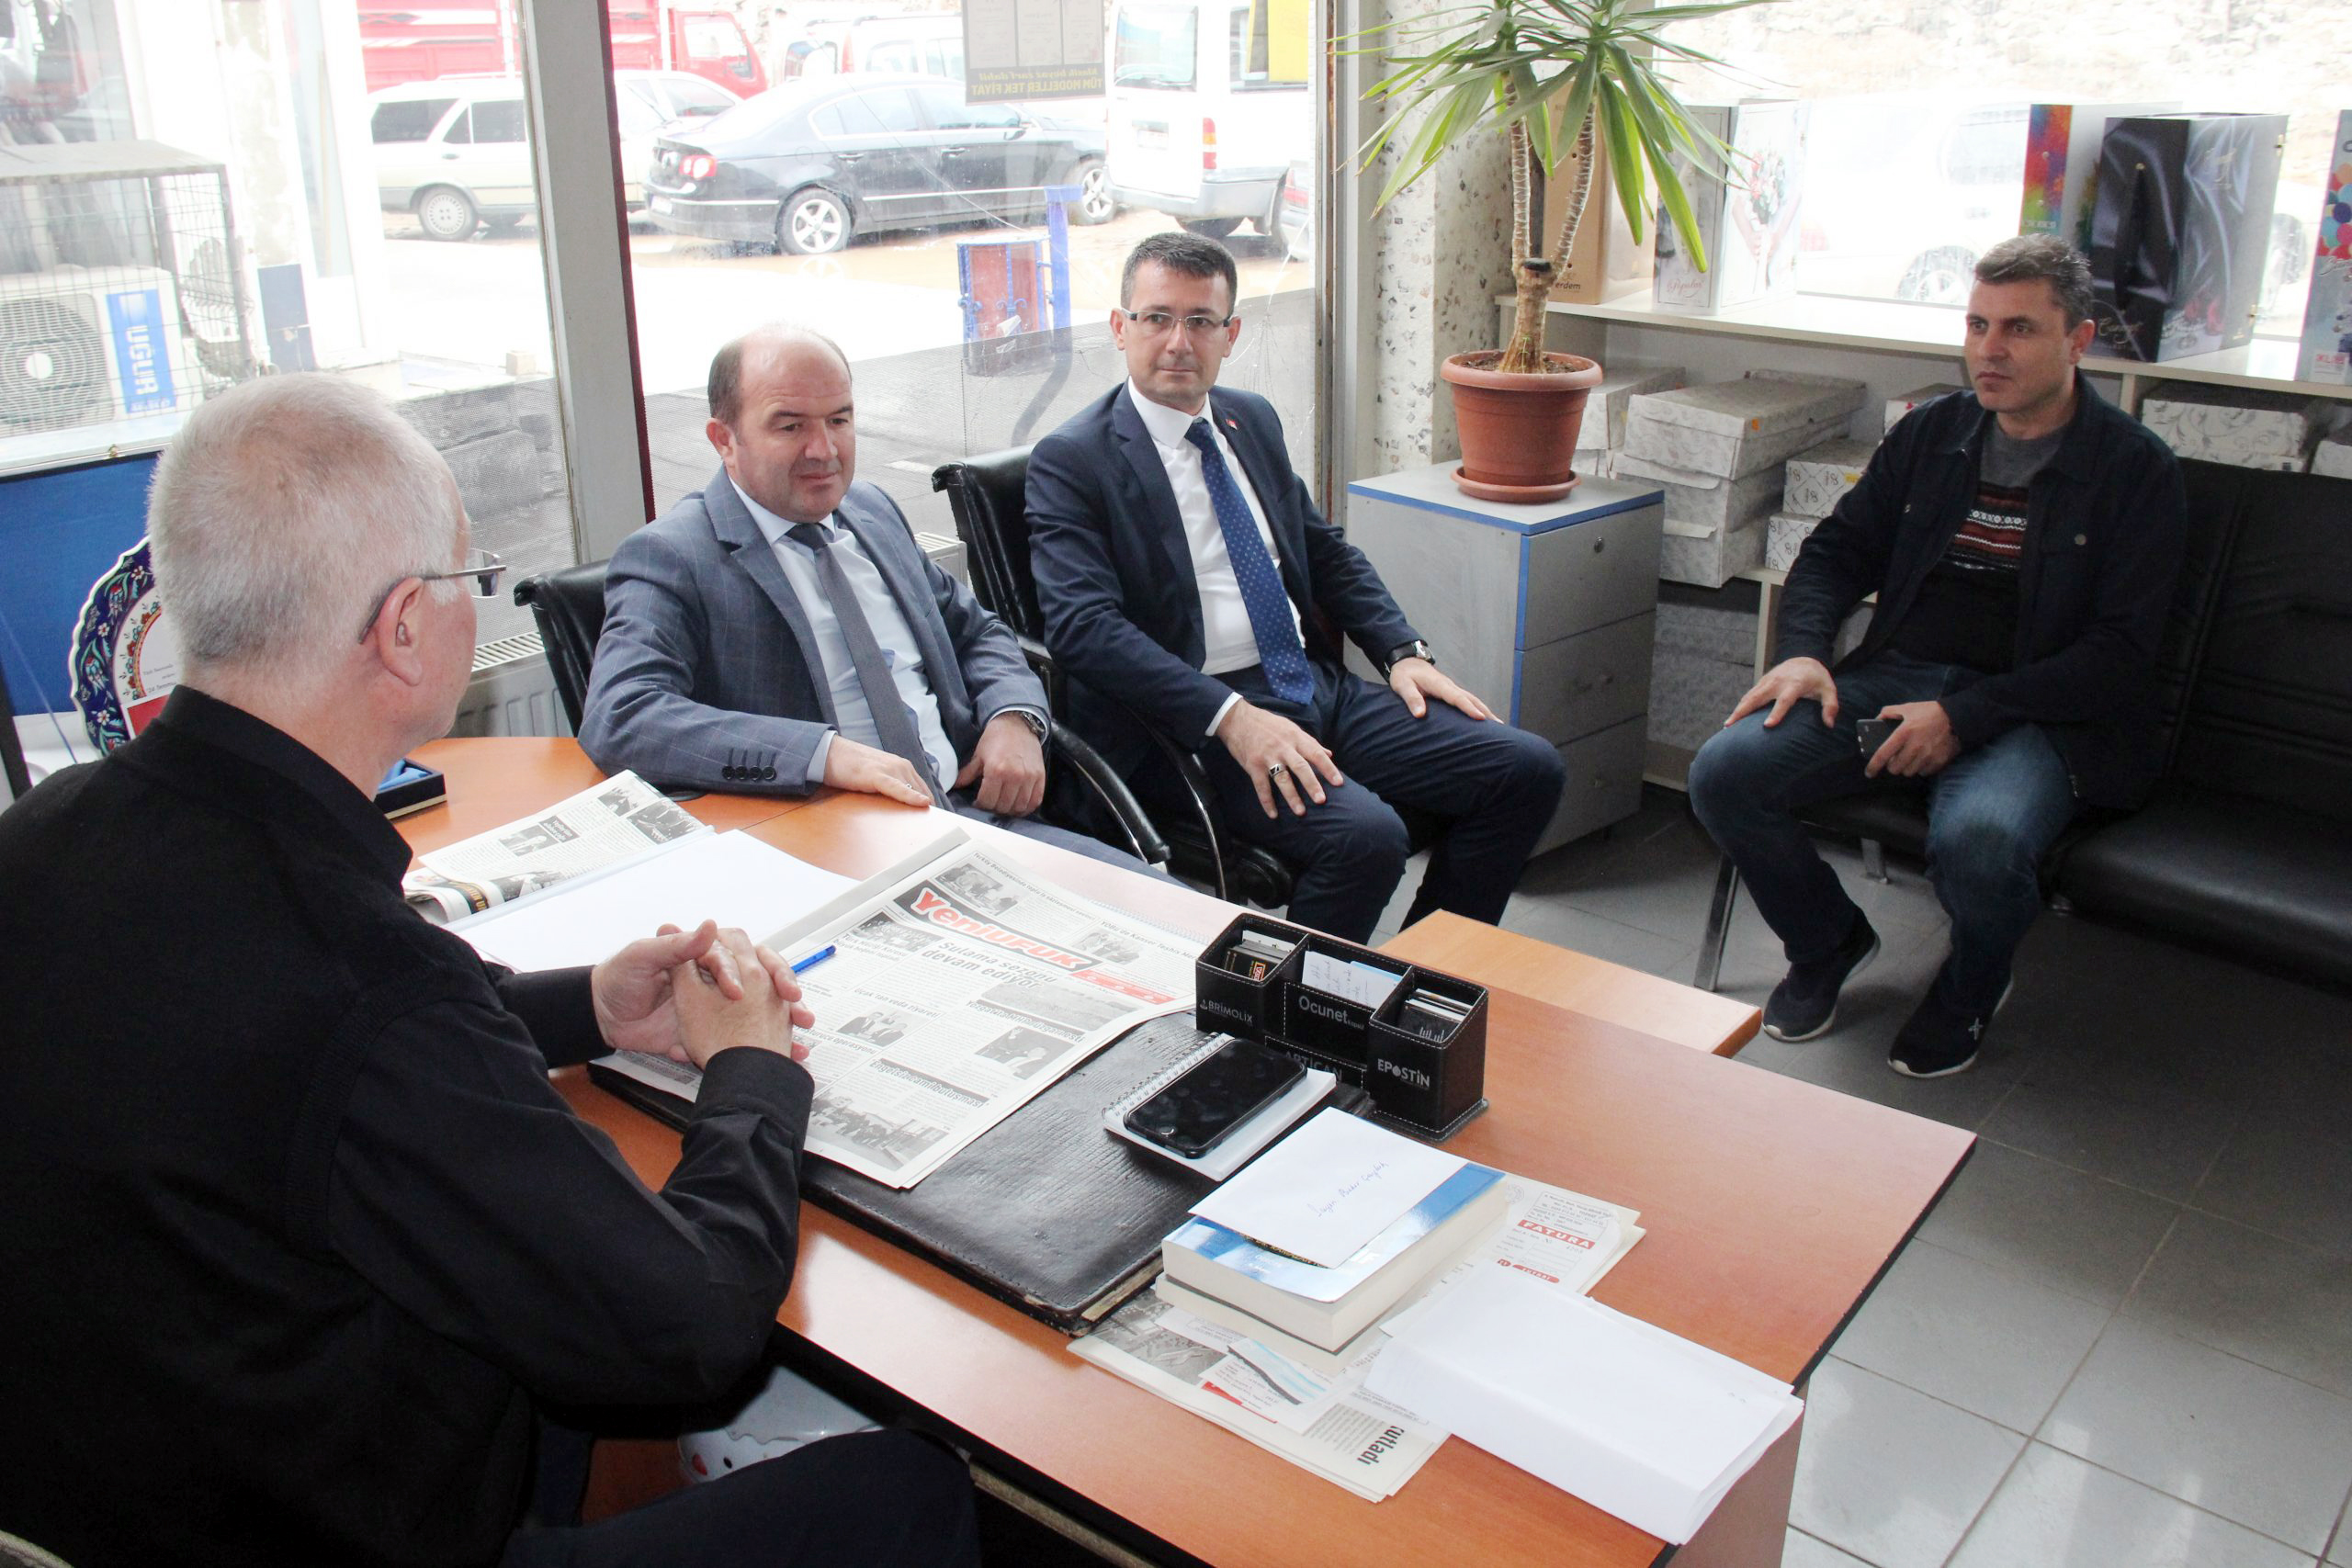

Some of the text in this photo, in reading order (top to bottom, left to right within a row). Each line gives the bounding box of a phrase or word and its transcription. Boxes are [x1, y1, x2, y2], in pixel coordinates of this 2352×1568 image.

[921, 948, 981, 972] devam
[980, 965, 1043, 990] ediyor
[938, 939, 1000, 965] Sulama
[998, 959, 1057, 983] sezonu
[1298, 995, 1349, 1024] Ocunet
[1522, 1221, 1590, 1248] FATURA
